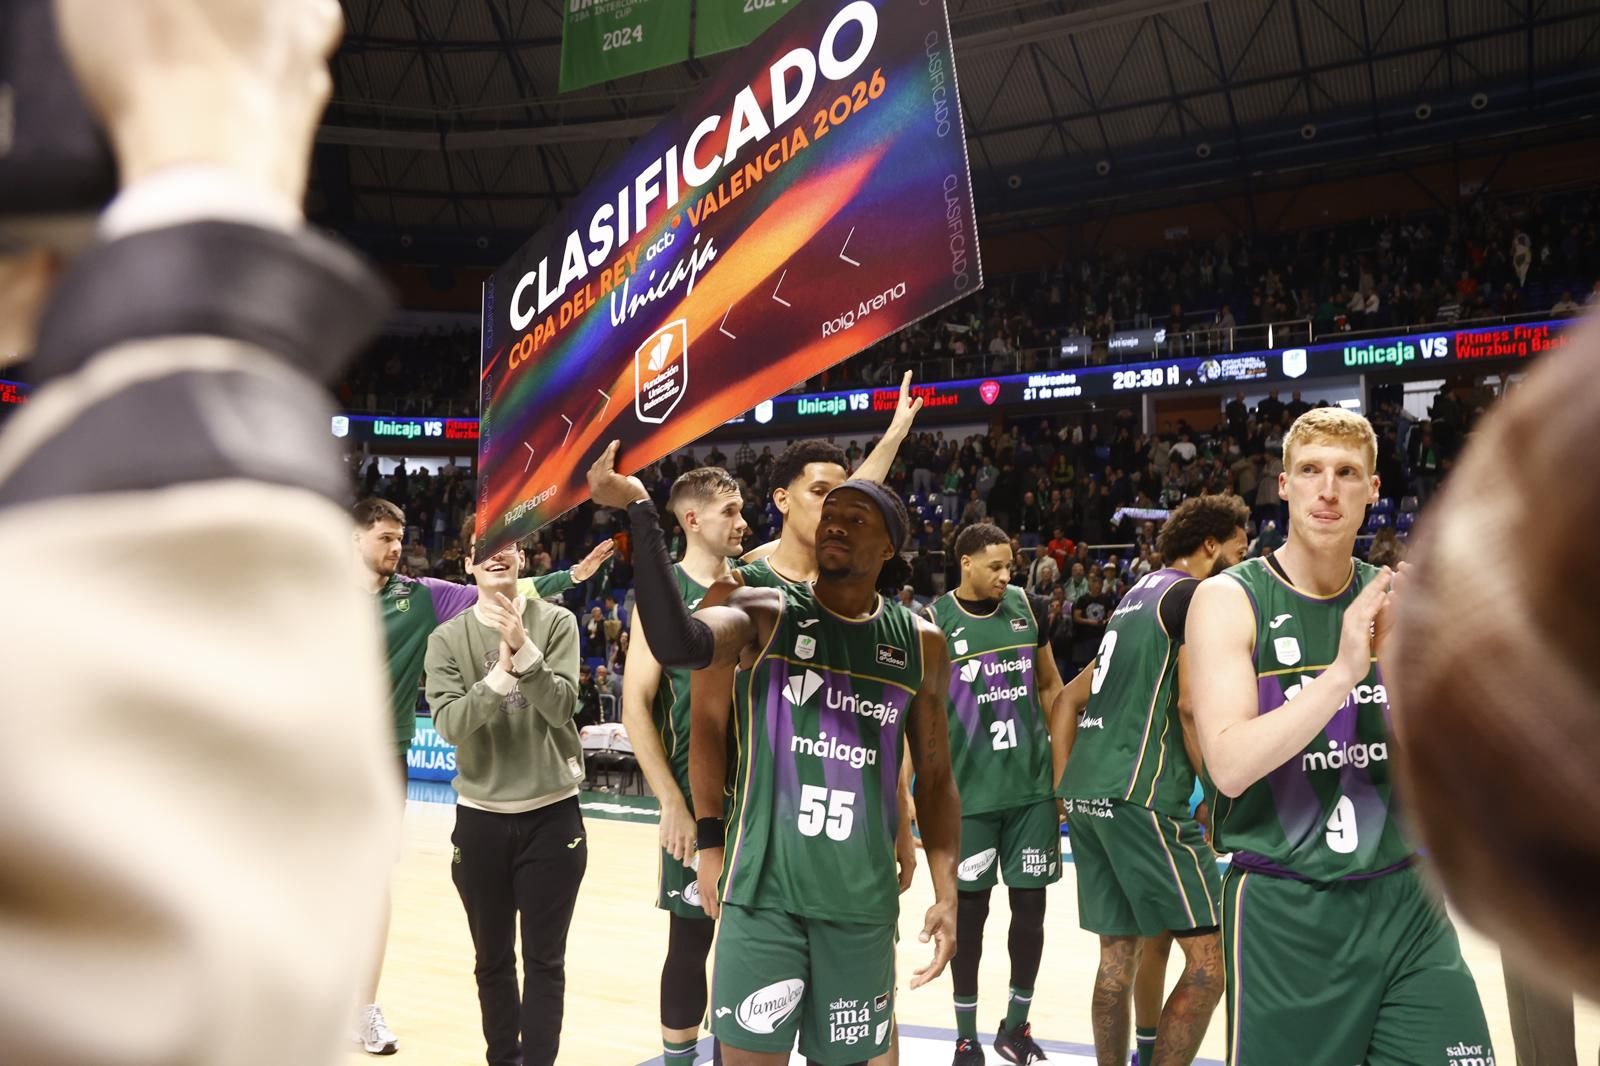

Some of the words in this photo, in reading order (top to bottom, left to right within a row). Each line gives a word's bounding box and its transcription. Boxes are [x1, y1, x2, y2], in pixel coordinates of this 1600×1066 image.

[602, 24, 643, 50] 2024
[925, 30, 951, 138] CLASIFICADO
[509, 0, 878, 331] CLASIFICADO
[508, 314, 556, 370] COPA
[559, 283, 596, 330] DEL
[600, 244, 643, 297] REY
[646, 231, 676, 261] acb
[686, 126, 810, 228] VALENCIA
[813, 67, 886, 141] 2026
[943, 174, 969, 290] CLASIFICADO
[610, 232, 718, 328] Unicaja
[822, 309, 855, 339] Roig
[857, 281, 906, 320] Arena
[1455, 331, 1510, 346] Fitness
[1513, 325, 1548, 340] First
[1344, 340, 1415, 366] Unicaja
[1419, 336, 1449, 359] VS
[1455, 341, 1527, 360] Wurzburg
[648, 378, 675, 400] Unicaja
[1112, 368, 1163, 390] 20:30
[797, 395, 847, 416] Unicaja
[849, 393, 869, 410] VS
[873, 389, 900, 401] Fitne
[1024, 387, 1037, 401] 21
[1039, 386, 1052, 399] de
[1053, 385, 1082, 398] enero
[373, 420, 422, 438] Unicaja
[424, 421, 442, 436] VS
[983, 656, 1032, 676] Unicaja
[826, 687, 899, 727] Unicaja
[989, 718, 1018, 751] 21
[407, 748, 457, 771] MIJAS
[797, 783, 857, 842] 55
[1325, 795, 1359, 854] 9
[829, 997, 859, 1011] sabor
[836, 1001, 871, 1026] má
[830, 1024, 870, 1045] laga
[1446, 1041, 1483, 1057] sabor
